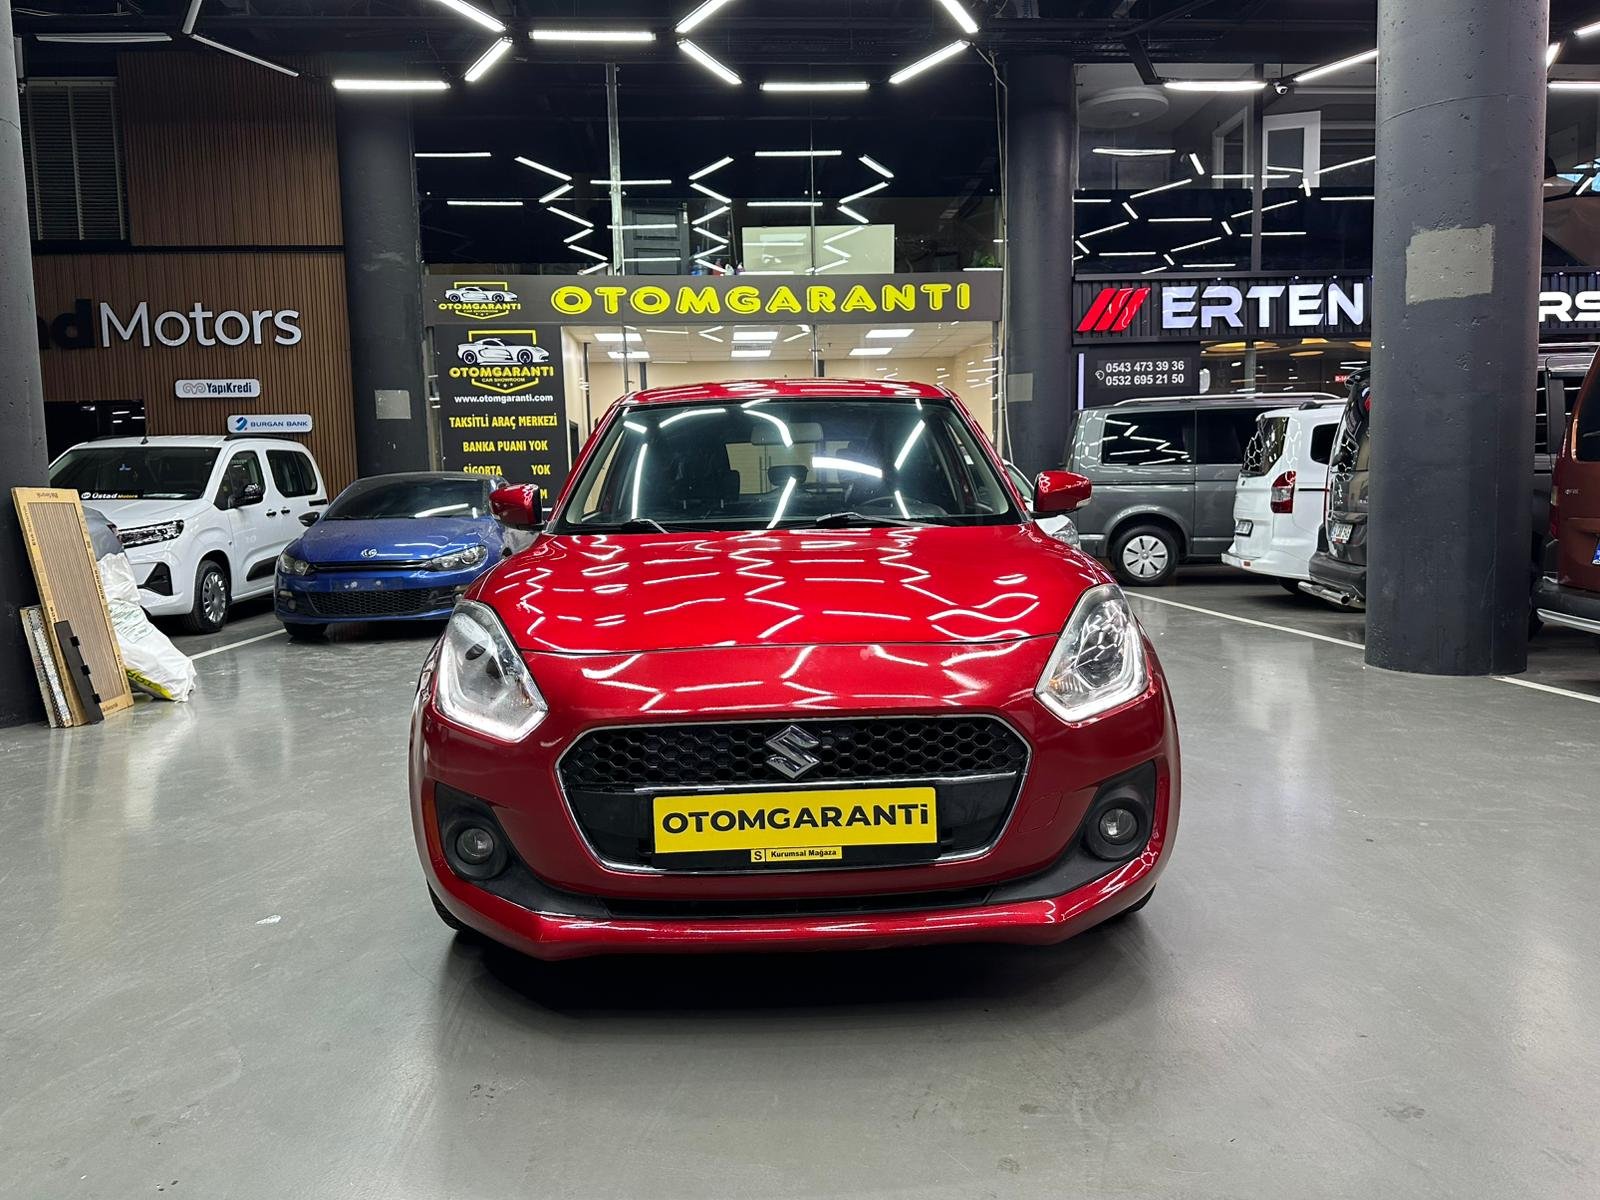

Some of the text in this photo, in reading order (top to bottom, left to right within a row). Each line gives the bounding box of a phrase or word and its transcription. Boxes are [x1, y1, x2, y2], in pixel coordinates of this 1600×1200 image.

[551, 283, 970, 315] OTOMGARANTI
[438, 303, 521, 311] OTOMGARANTI
[1162, 282, 1364, 329] ERTEN
[99, 301, 301, 347] Motors
[449, 366, 554, 377] OTOMGARANTI
[1105, 360, 1185, 373] 0543 473 39 36
[1105, 374, 1184, 386] 0532 695 21 50
[454, 394, 553, 404] www.otomgaranti.com
[449, 412, 558, 430] TAKSİTLİ ARAÇ MERKEZİ
[463, 440, 548, 452] BANKA PUANI YOK
[531, 464, 551, 475] YOK
[754, 849, 837, 860] S Kurumsal Mağaza
